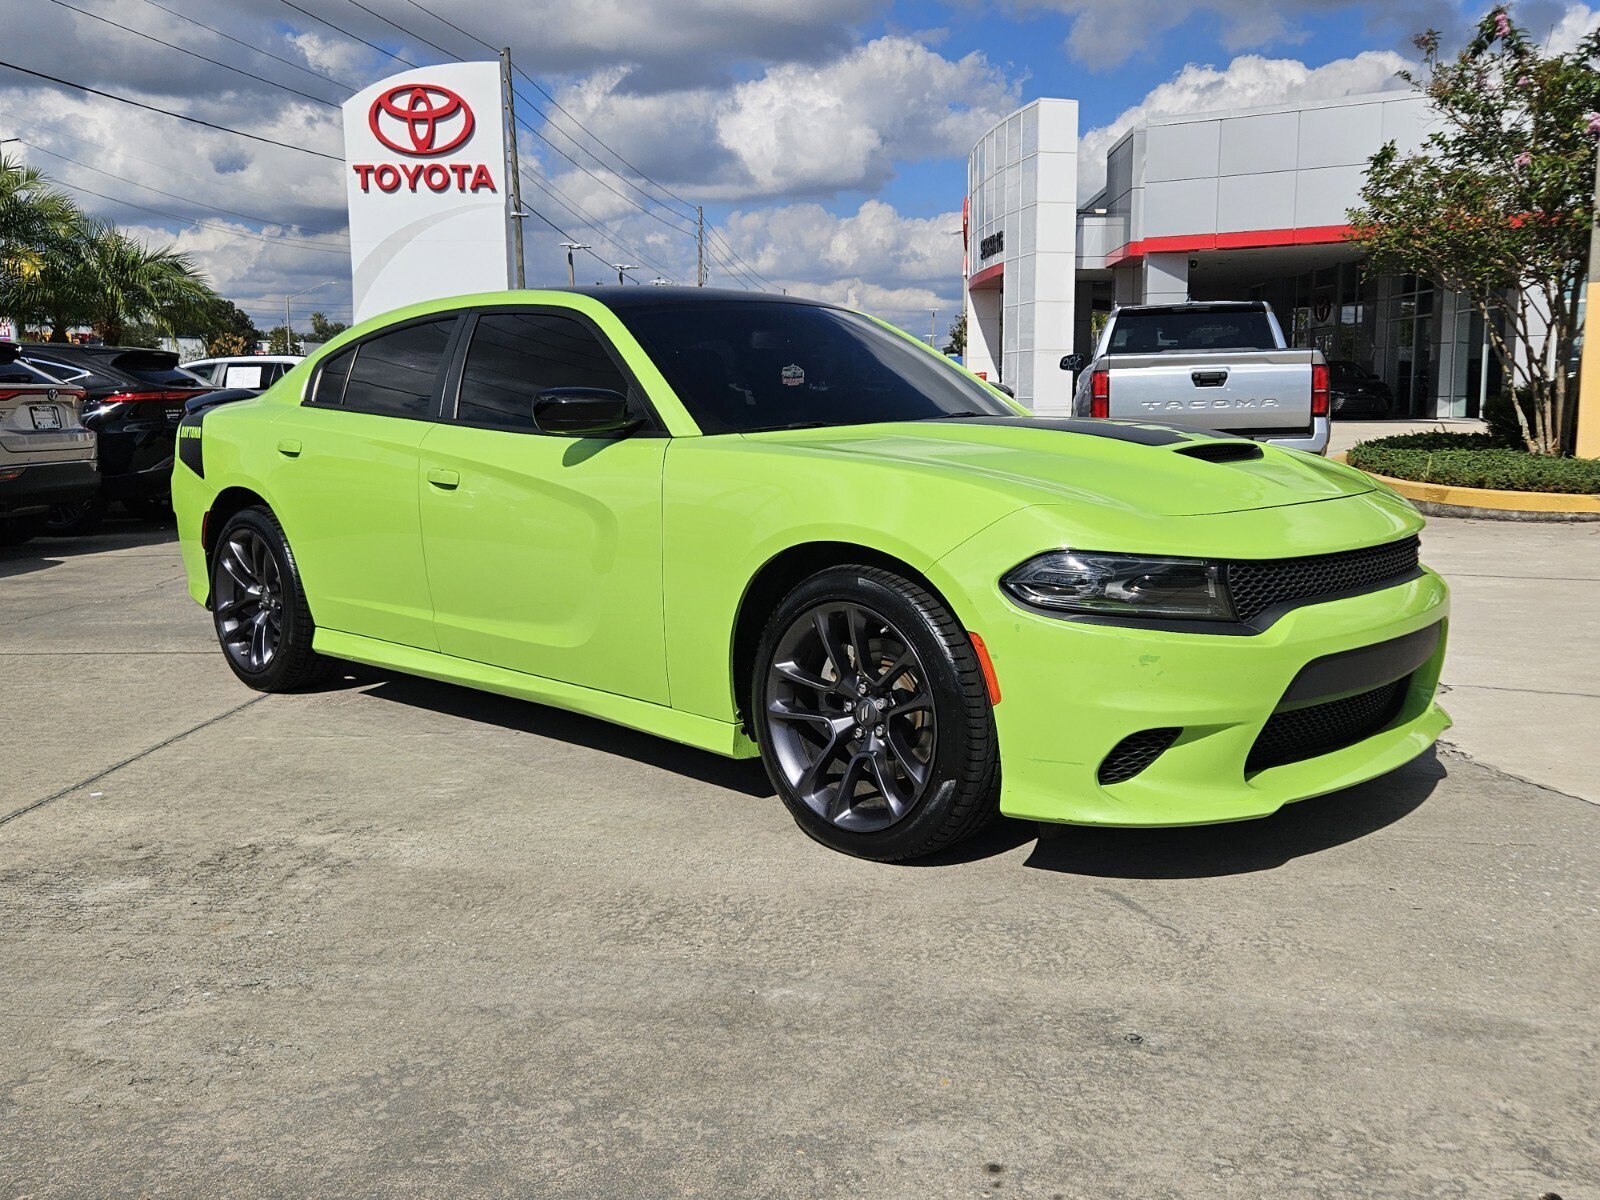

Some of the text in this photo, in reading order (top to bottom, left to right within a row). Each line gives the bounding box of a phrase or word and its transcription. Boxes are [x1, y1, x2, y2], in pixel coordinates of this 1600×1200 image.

[352, 163, 497, 192] TOYOTA
[1141, 398, 1280, 411] TACOMA
[180, 425, 202, 439] DAYTONA
